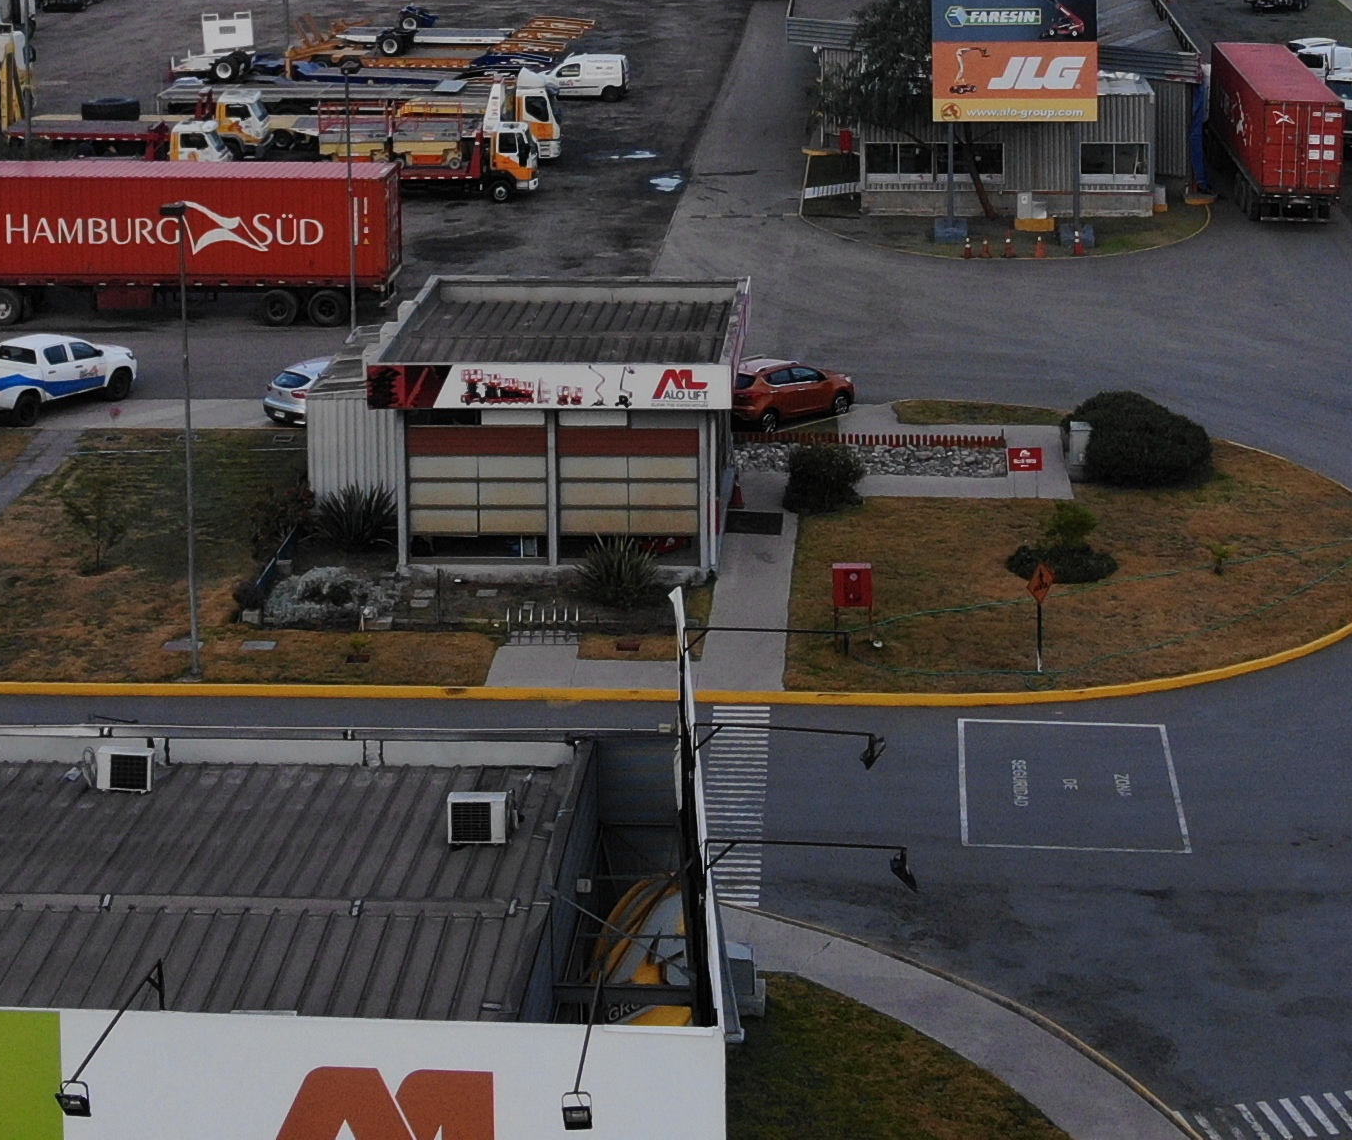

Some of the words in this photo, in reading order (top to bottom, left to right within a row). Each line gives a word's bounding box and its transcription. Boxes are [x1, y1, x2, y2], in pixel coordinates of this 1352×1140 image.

[969, 11, 1037, 23] FARESIN
[987, 56, 1087, 90] JLG
[5, 213, 180, 245] HAMBURG
[251, 213, 324, 246] SÜD
[663, 391, 686, 401] ALO
[688, 391, 708, 400] LIFT
[1011, 759, 1029, 807] SEGURIDAD
[1062, 778, 1078, 791] DE
[1113, 773, 1132, 797] ZONA
